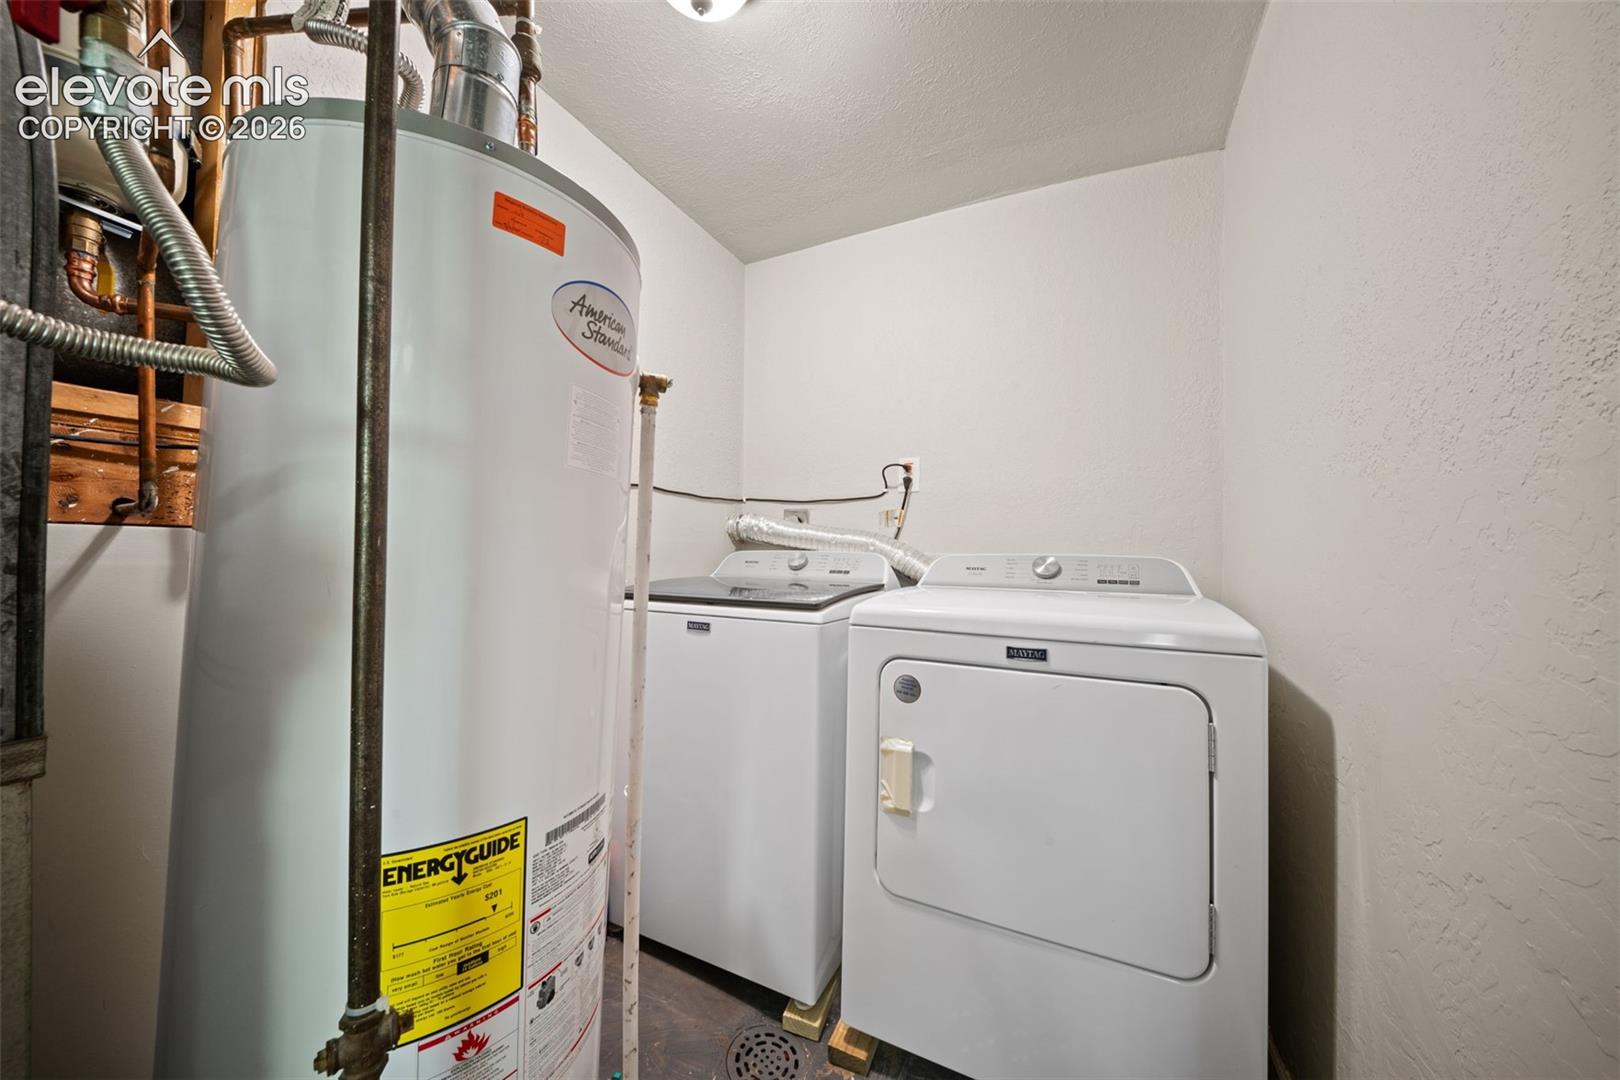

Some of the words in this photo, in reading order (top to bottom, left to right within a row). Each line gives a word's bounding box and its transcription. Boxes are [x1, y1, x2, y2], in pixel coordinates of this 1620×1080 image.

[569, 293, 627, 337] American
[1008, 648, 1046, 660] MAYTAG
[383, 831, 521, 887] ENERGYGUIDE
[425, 897, 449, 909] Estimated
[450, 891, 465, 902] Yearly
[466, 886, 481, 896] Energy
[432, 961, 447, 971] water
[447, 958, 457, 967] you
[458, 953, 466, 962] get
[473, 947, 481, 955] the
[433, 955, 447, 964] First
[449, 950, 463, 959] Hour
[464, 942, 483, 953] Rating
[454, 1010, 499, 1035] WARNING
